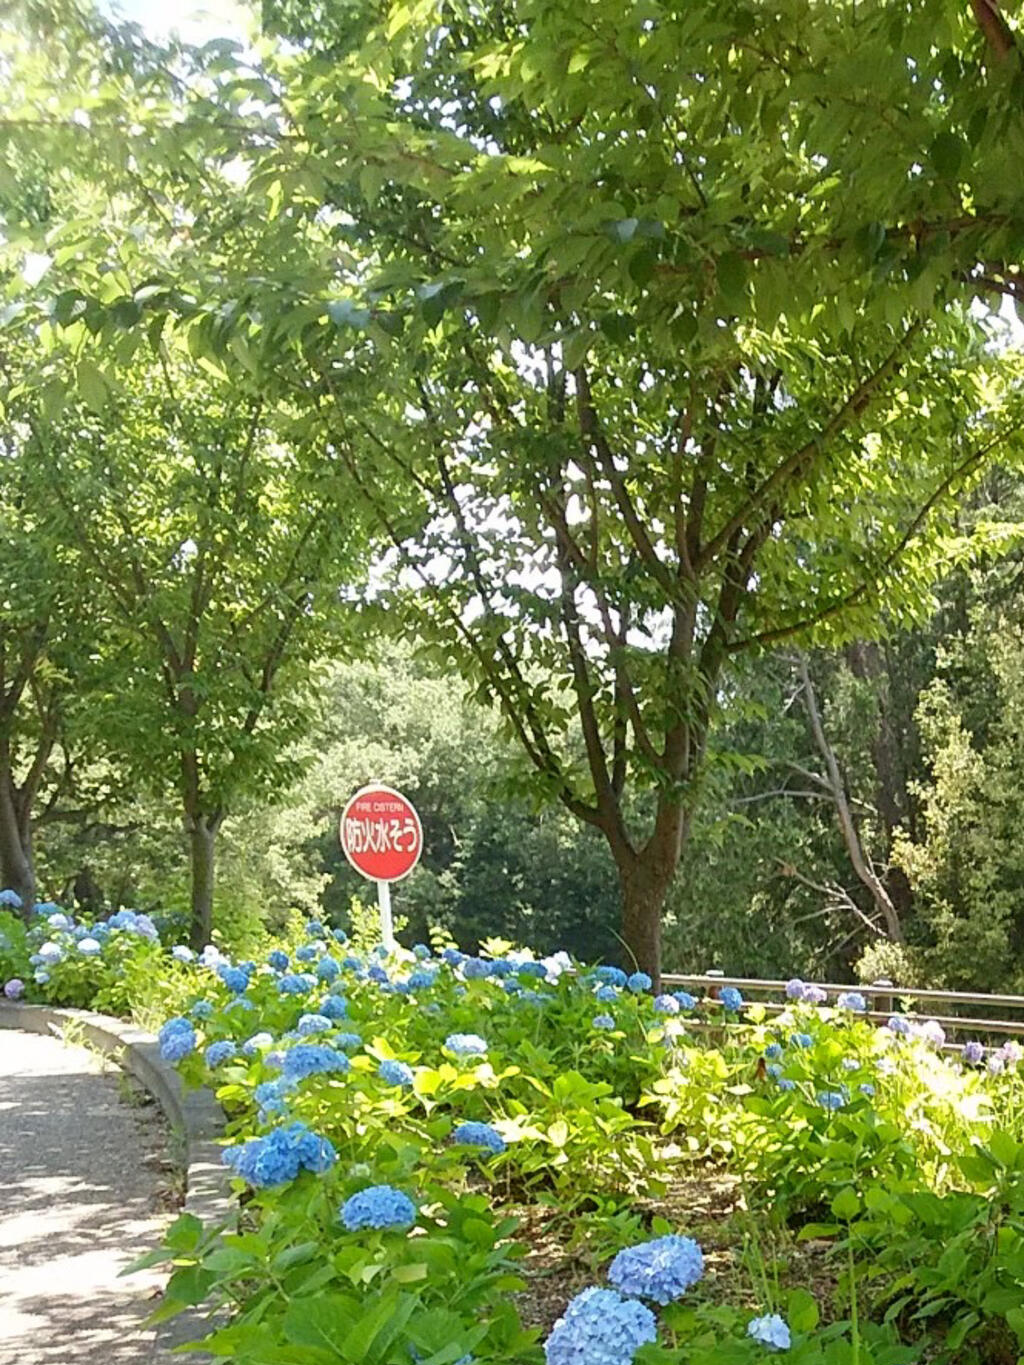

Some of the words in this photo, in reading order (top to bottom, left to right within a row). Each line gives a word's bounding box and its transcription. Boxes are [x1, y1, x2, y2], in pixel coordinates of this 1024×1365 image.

[346, 817, 418, 853] 防火水そう
